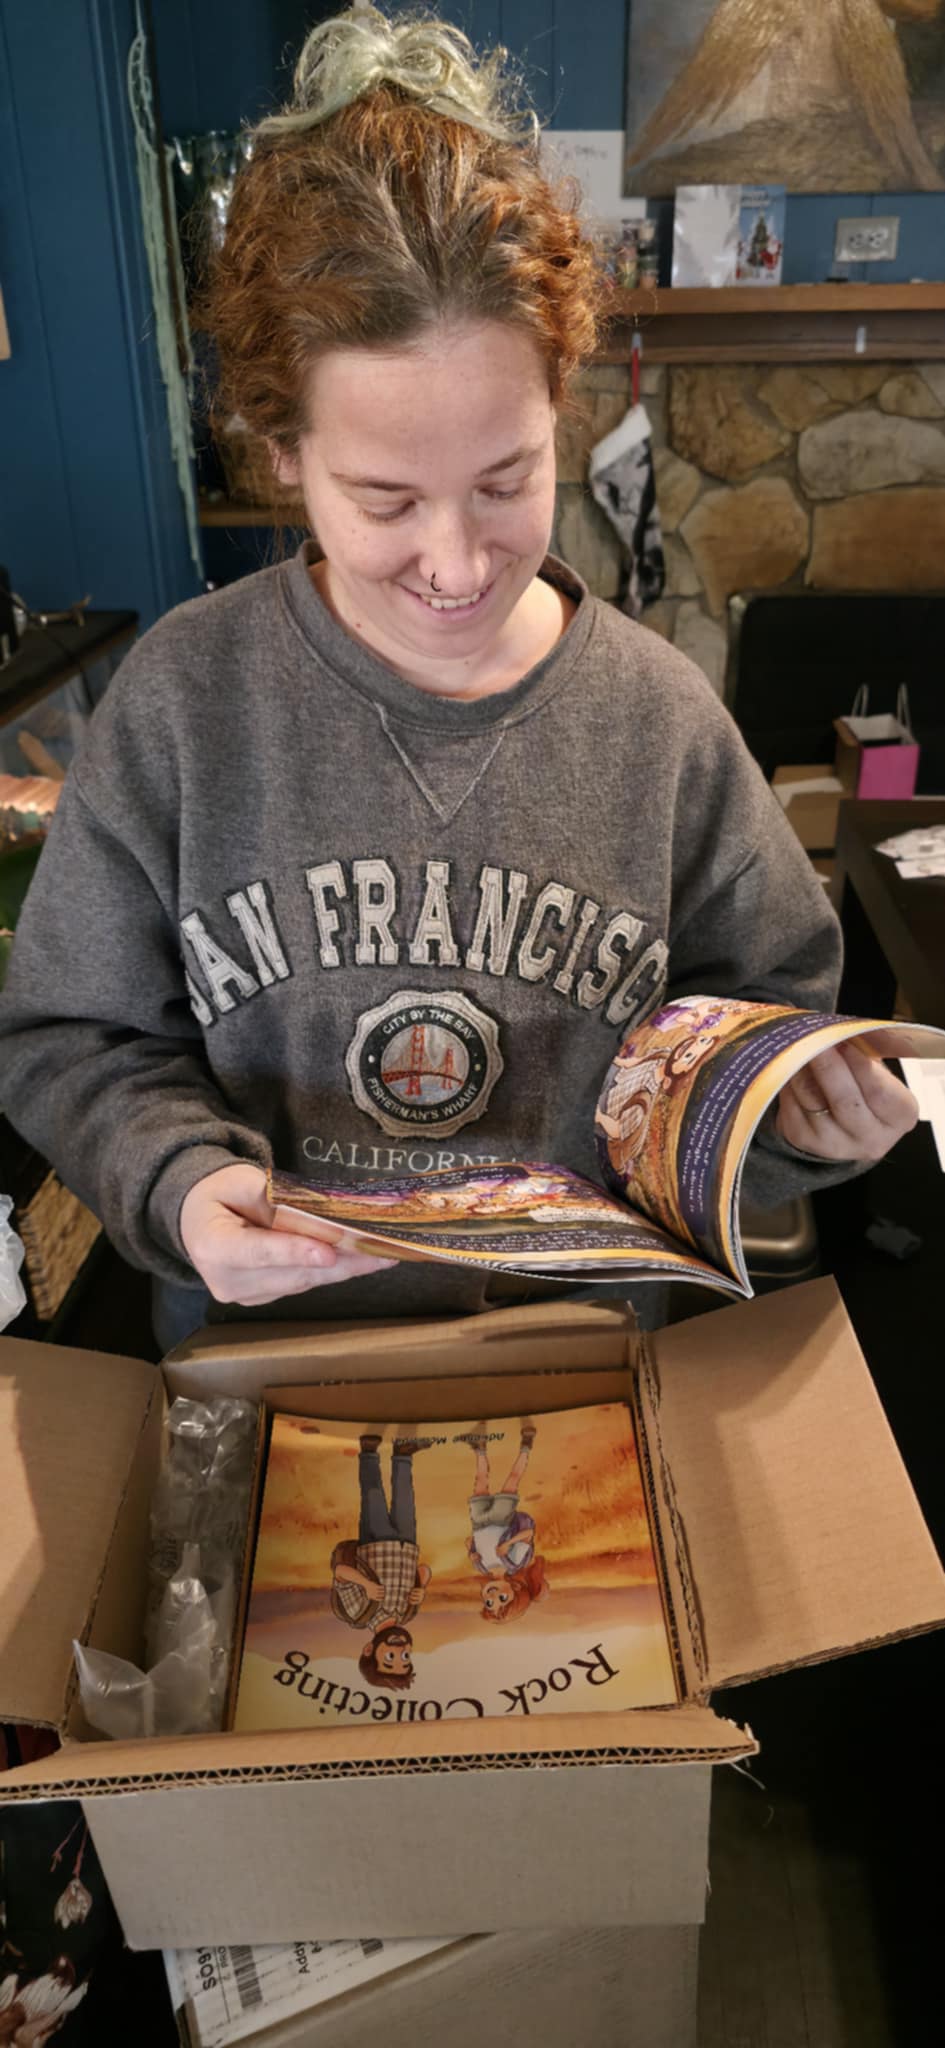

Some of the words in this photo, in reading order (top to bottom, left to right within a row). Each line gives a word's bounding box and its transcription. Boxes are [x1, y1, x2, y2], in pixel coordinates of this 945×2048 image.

[306, 860, 669, 1037] FRANCISC
[383, 1011, 407, 1034] CITY
[410, 1009, 426, 1021] BY
[429, 1009, 453, 1023] THE
[453, 1019, 476, 1040] BAY
[368, 1077, 440, 1120] FISHERMAN'S
[442, 1084, 478, 1117] WHARF
[302, 1136, 517, 1172] CALIFORN
[499, 1643, 620, 1715] Rock
